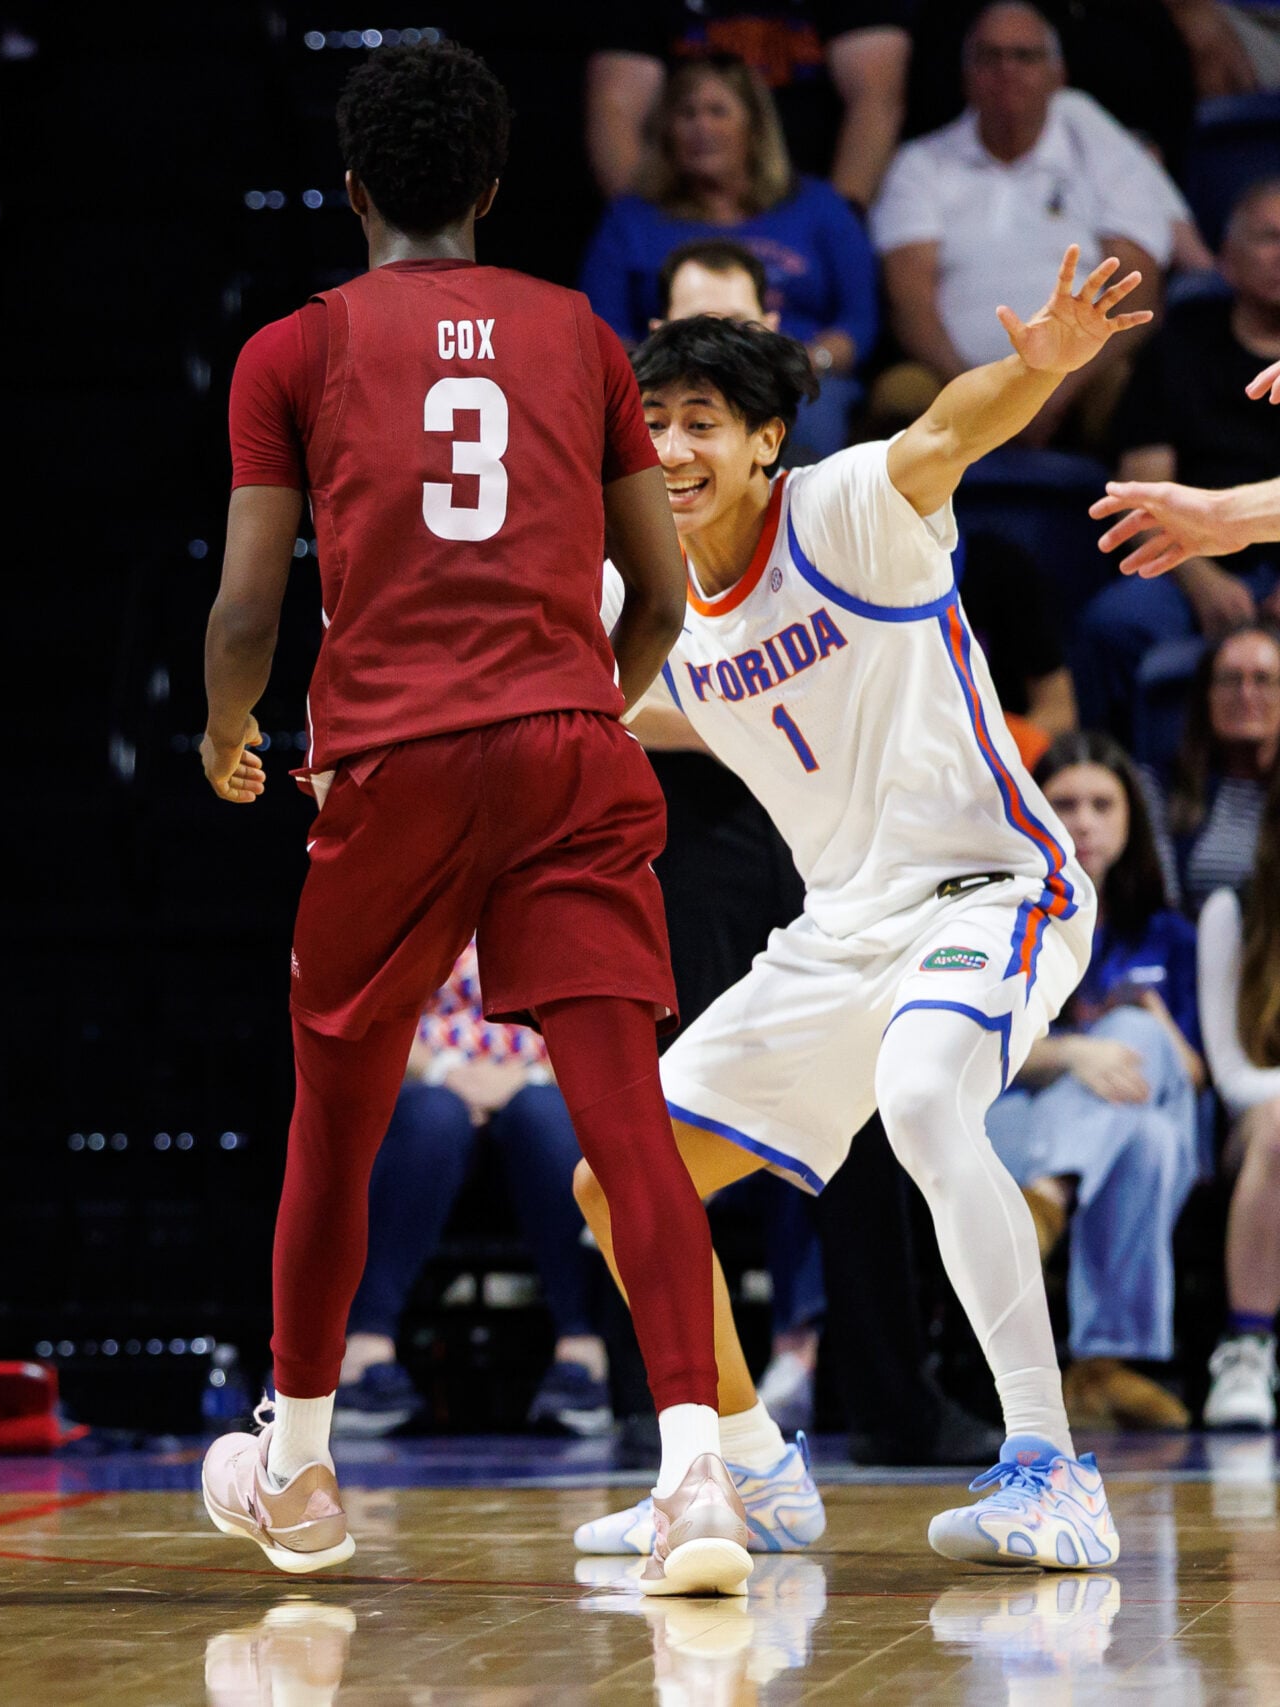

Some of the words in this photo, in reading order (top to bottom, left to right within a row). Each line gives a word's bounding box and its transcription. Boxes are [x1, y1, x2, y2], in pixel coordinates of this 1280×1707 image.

[437, 318, 496, 360] COX
[422, 376, 509, 542] 3
[771, 703, 820, 774] 1
